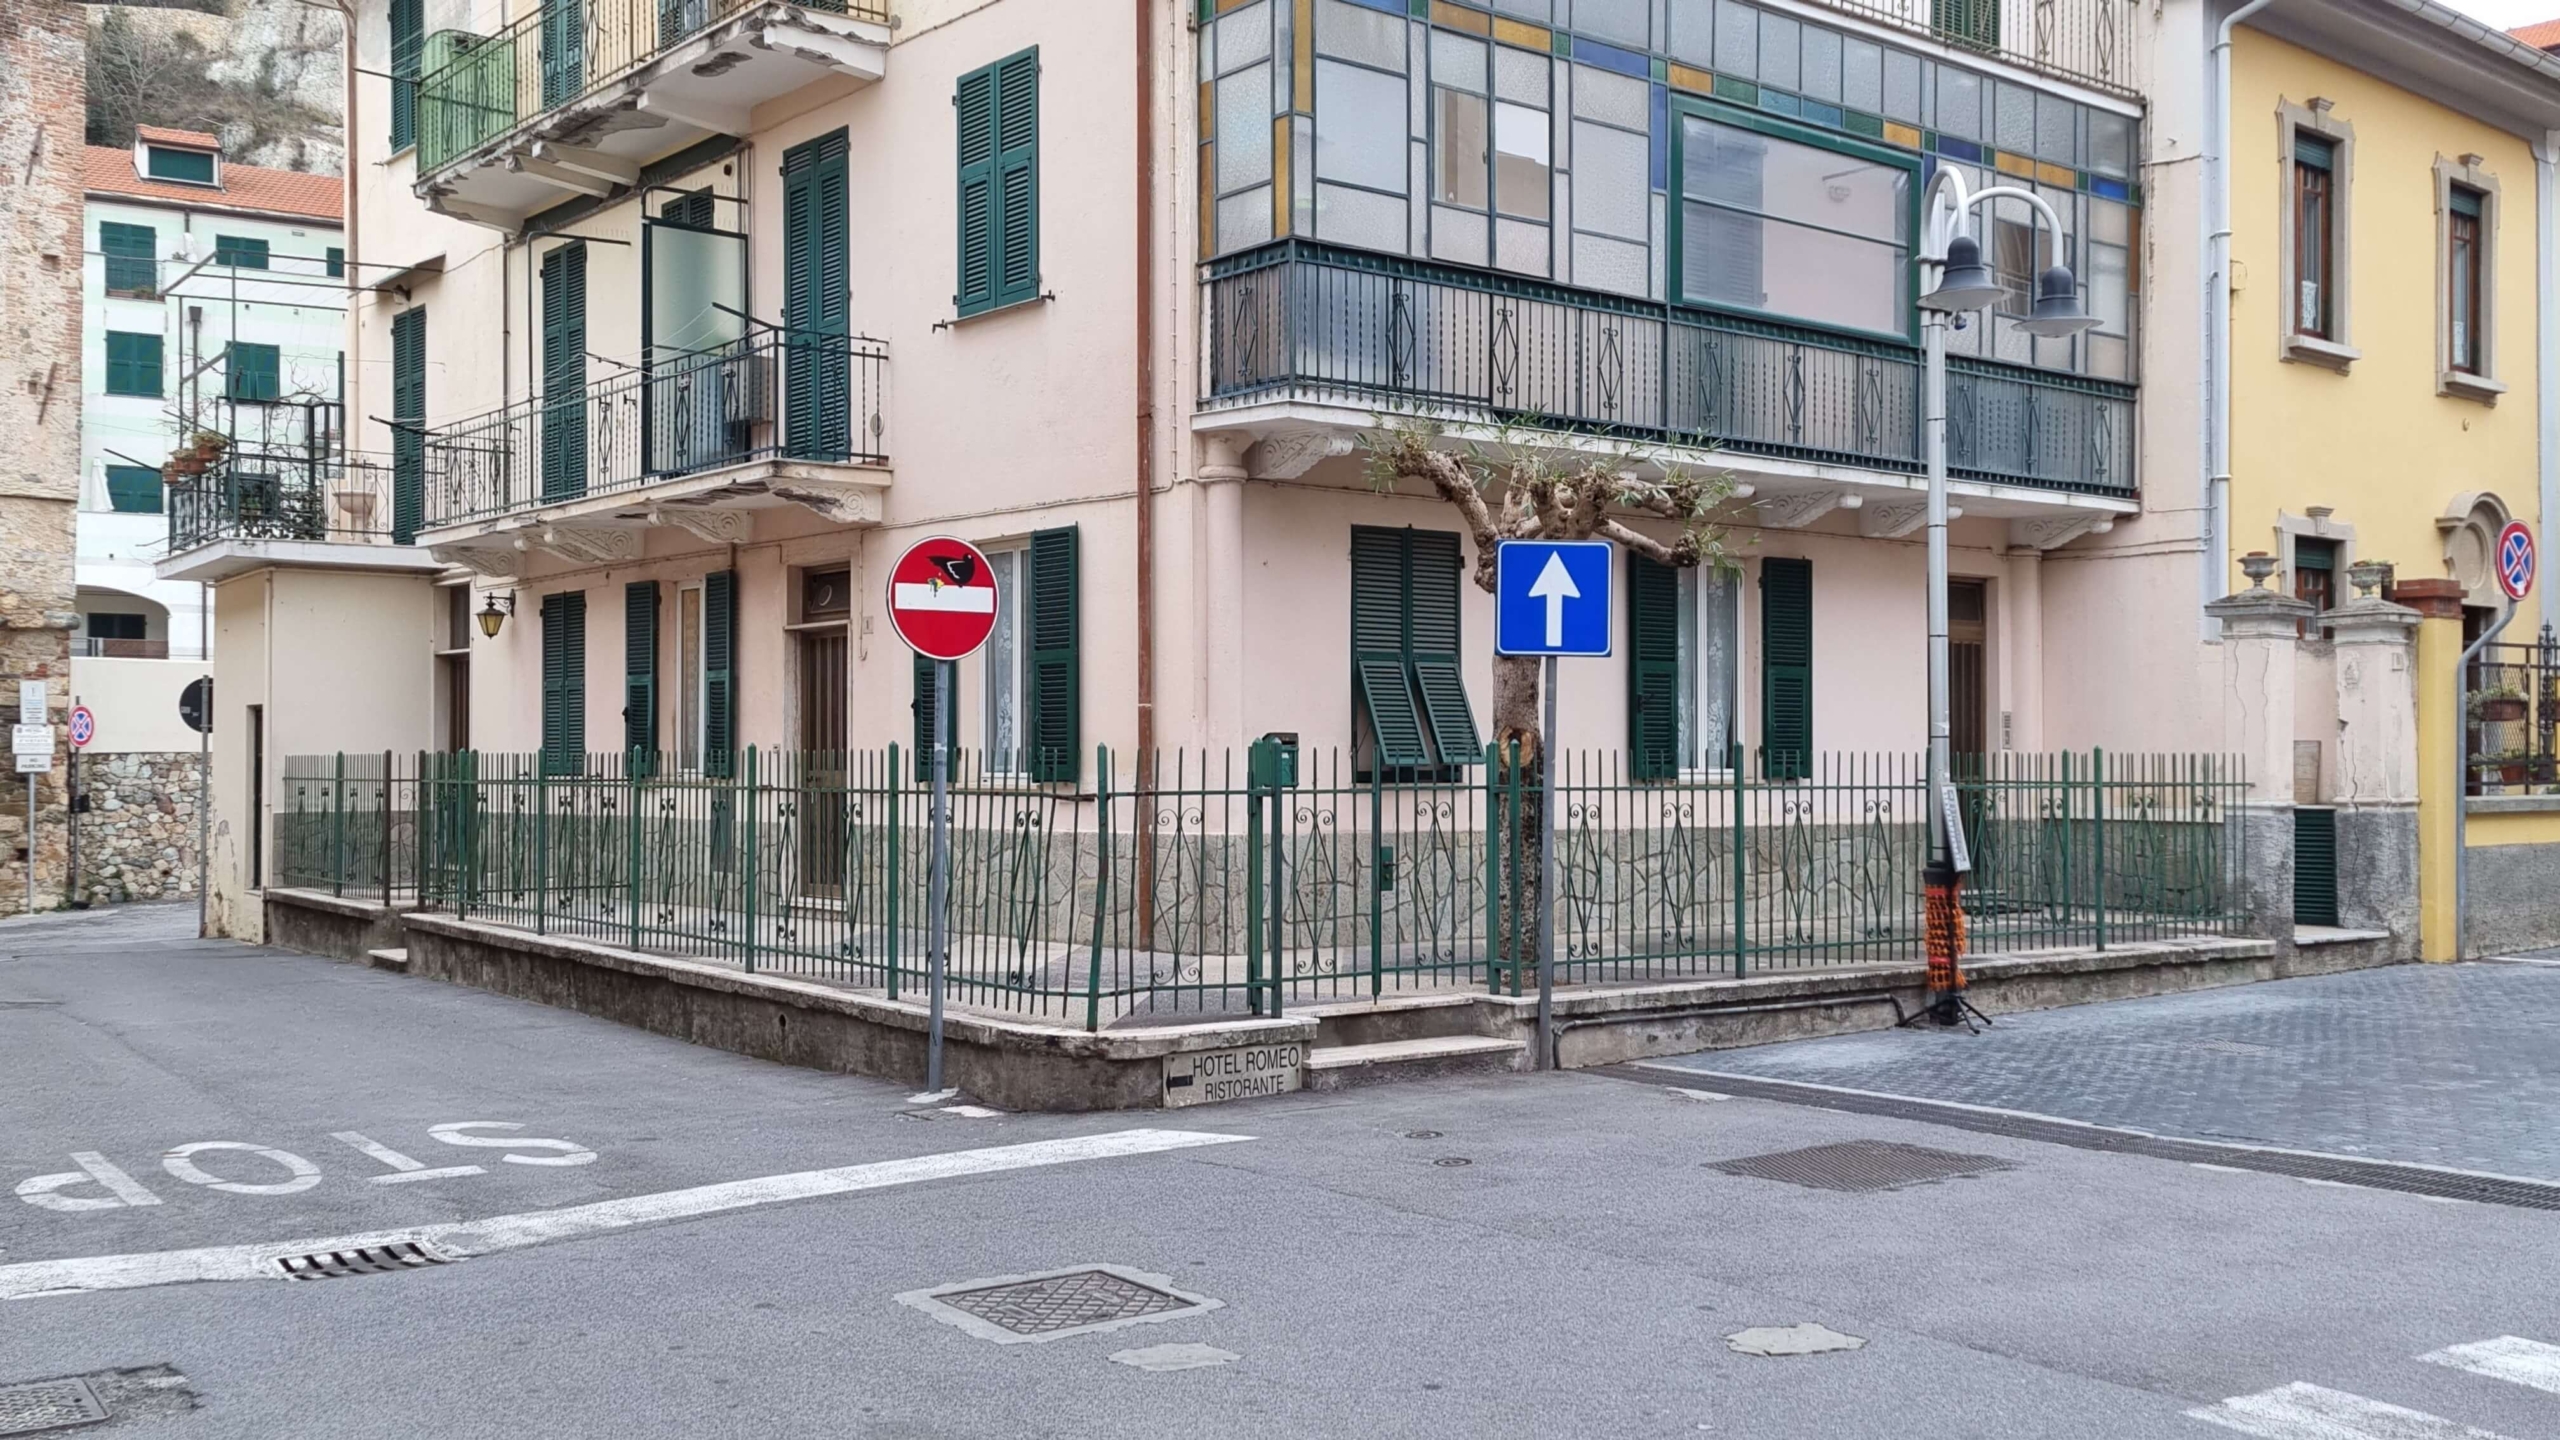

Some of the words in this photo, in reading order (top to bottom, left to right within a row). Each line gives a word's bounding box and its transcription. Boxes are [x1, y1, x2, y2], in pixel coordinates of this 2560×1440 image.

[1193, 1053, 1241, 1078] HOTEL
[1246, 1046, 1299, 1072] ROMEO
[1205, 1074, 1285, 1101] RISTORANTE
[15, 1120, 599, 1212] STOP
